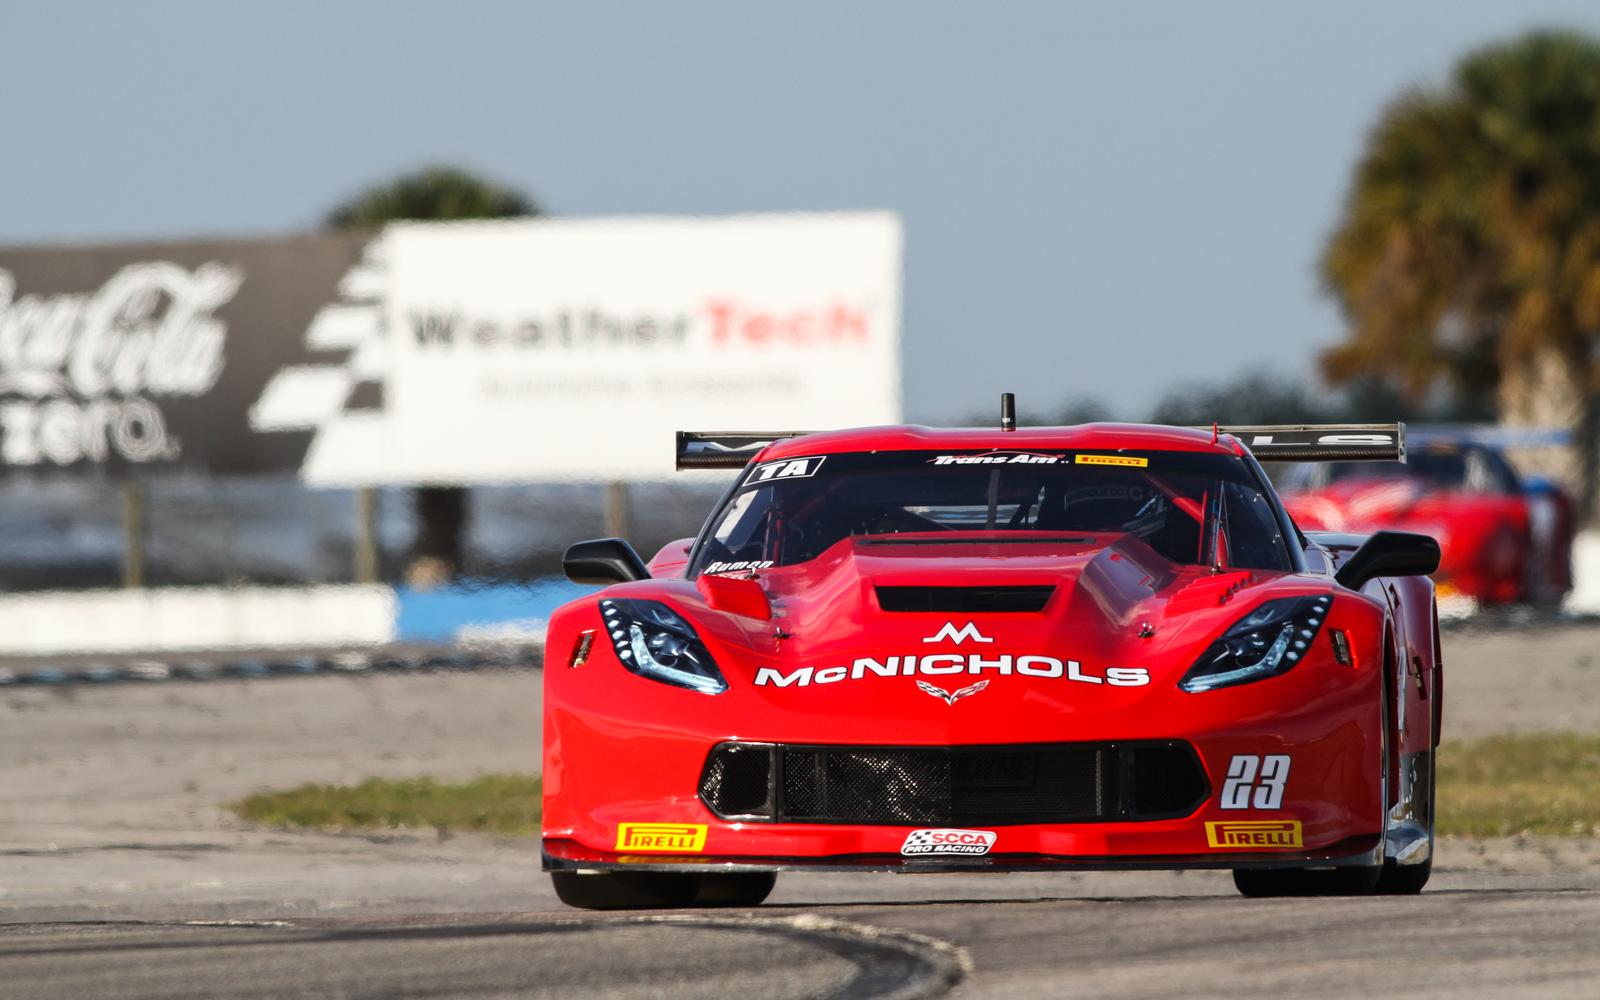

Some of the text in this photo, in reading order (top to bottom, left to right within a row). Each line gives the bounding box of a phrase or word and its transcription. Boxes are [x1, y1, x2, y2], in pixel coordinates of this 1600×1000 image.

[407, 301, 869, 348] WeatherTech
[758, 459, 809, 481] TA
[933, 455, 1007, 465] Trans
[1008, 454, 1057, 465] Am
[754, 653, 1151, 688] McNICHOLS
[1220, 754, 1291, 810] 23
[623, 826, 698, 848] PIRELLI
[931, 833, 988, 845] SCCA
[1214, 822, 1296, 846] PIRELLI
[904, 845, 986, 853] PRO RACING
